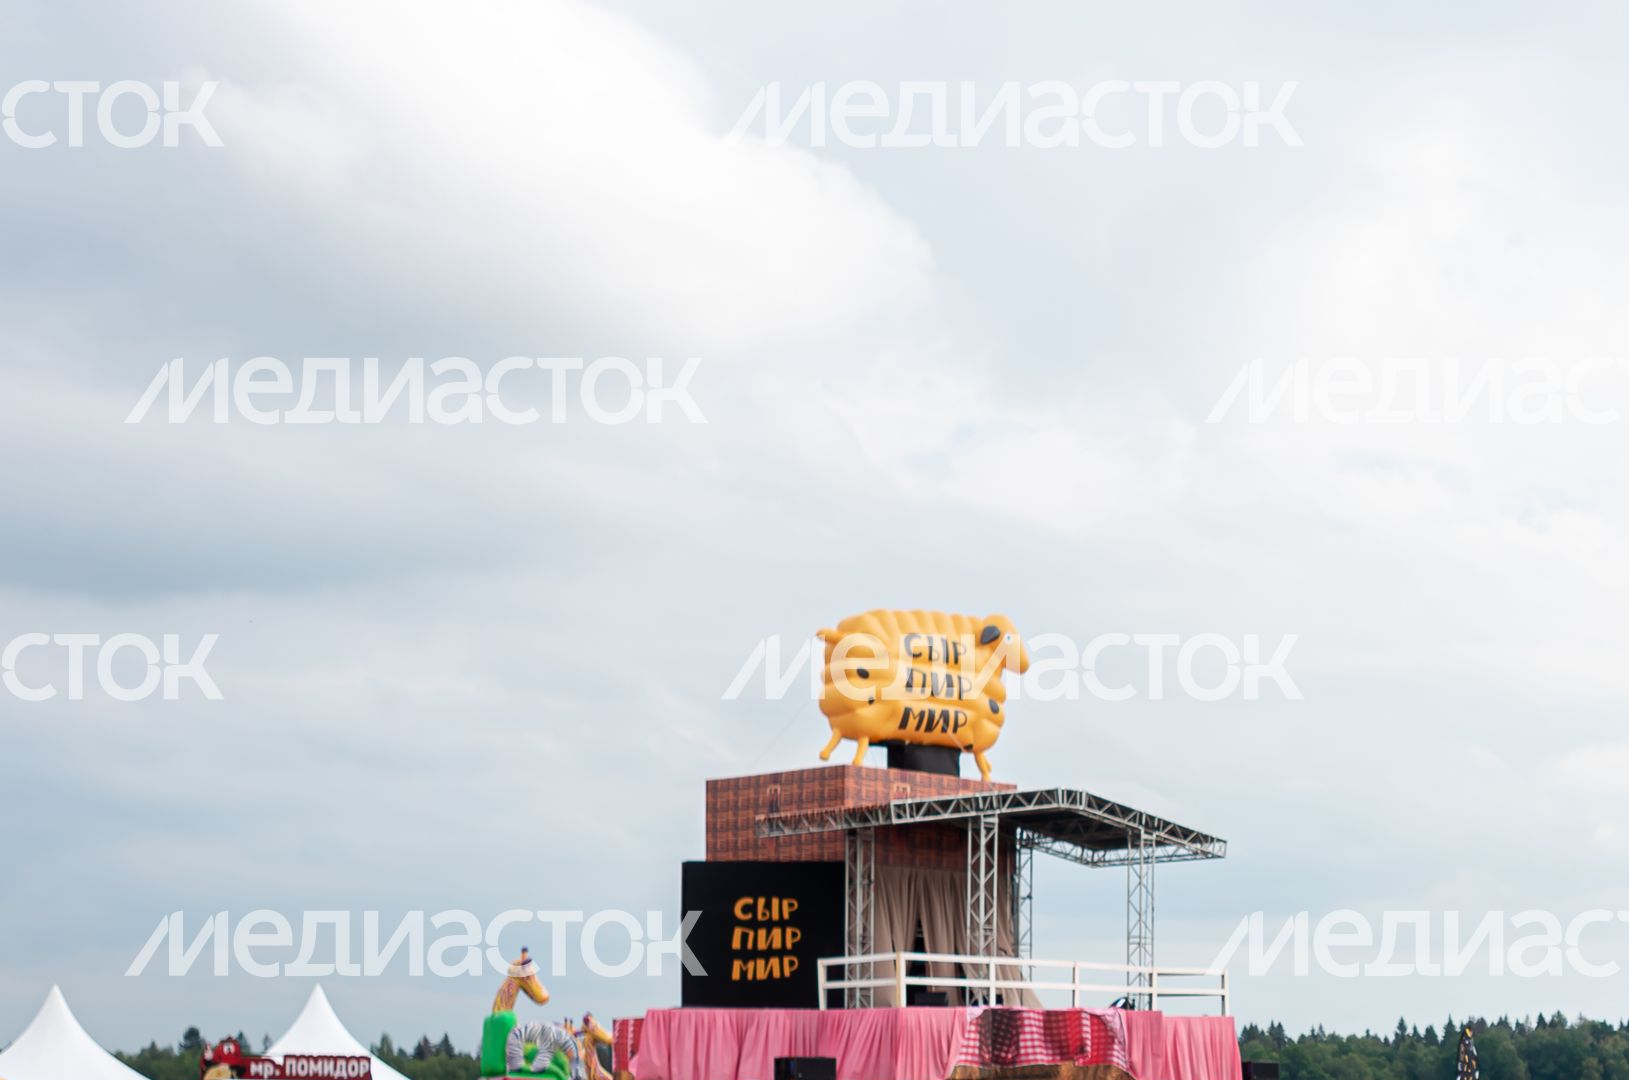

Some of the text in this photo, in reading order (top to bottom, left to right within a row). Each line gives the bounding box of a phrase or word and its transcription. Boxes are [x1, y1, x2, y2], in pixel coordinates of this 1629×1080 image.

[903, 633, 967, 665] СЫР
[905, 667, 973, 701] ПИР
[898, 706, 968, 734] МИР
[733, 896, 799, 922] СЫР
[731, 926, 802, 951] ПИР
[731, 955, 799, 981] МИР
[285, 1056, 370, 1080] ПОМИДОР
